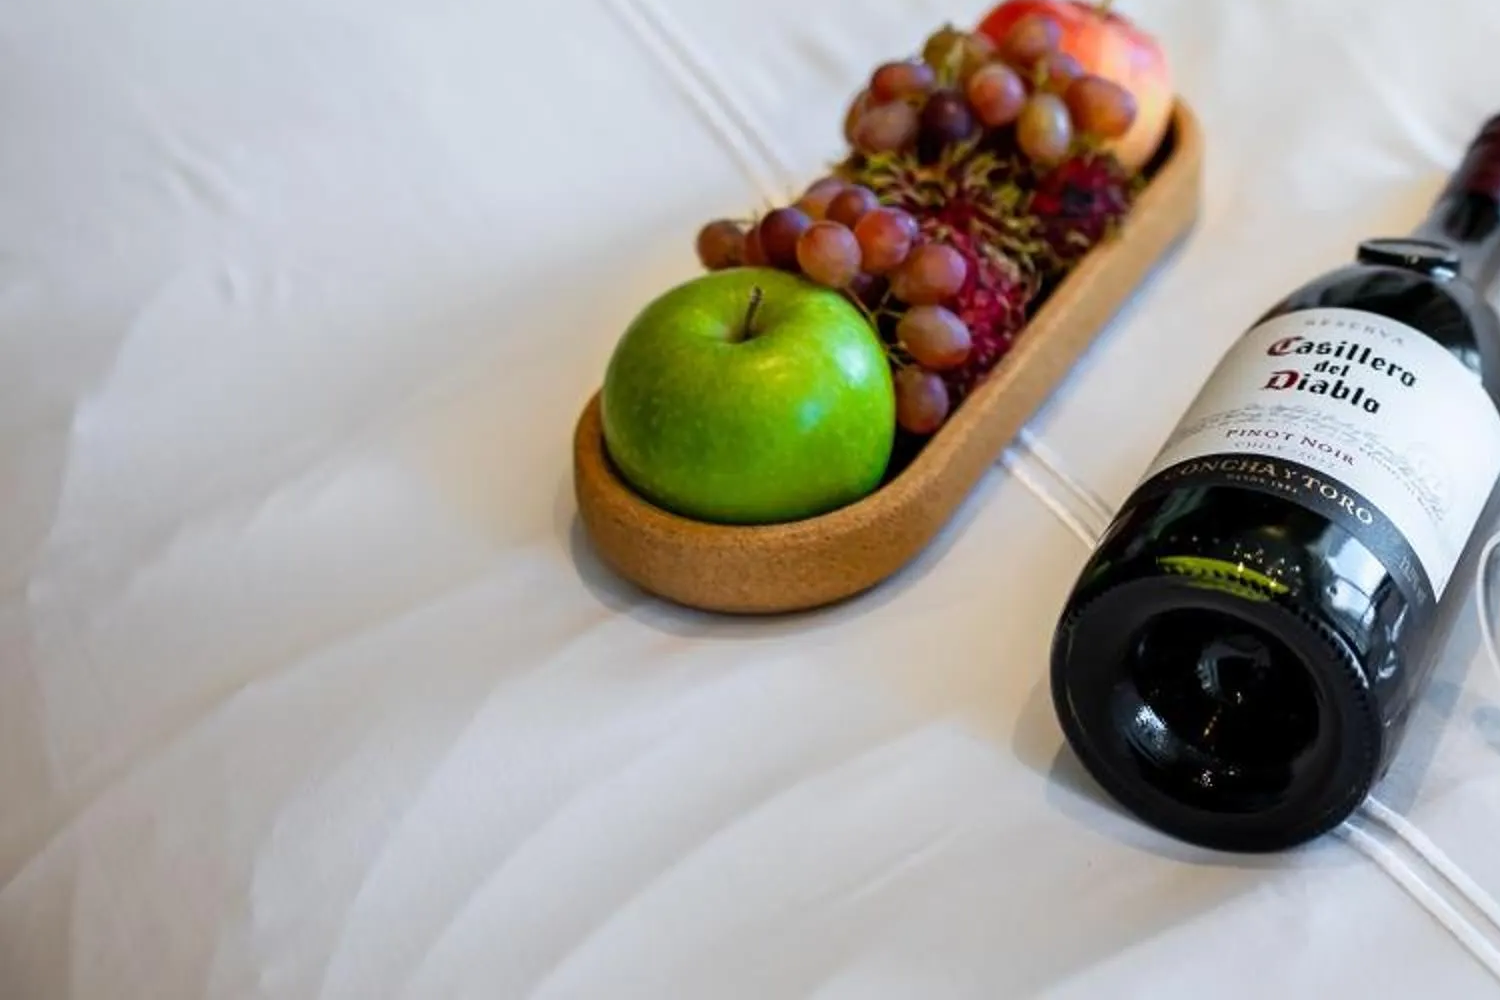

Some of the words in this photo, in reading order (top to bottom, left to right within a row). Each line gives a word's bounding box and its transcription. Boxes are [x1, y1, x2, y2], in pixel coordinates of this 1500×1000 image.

[1266, 335, 1417, 387] Casillero
[1313, 360, 1350, 377] del
[1261, 369, 1381, 414] Diablo
[1225, 428, 1295, 441] PINOT
[1300, 436, 1355, 466] NOIR
[1163, 457, 1277, 481] CONCHA
[1302, 474, 1374, 525] TORO
